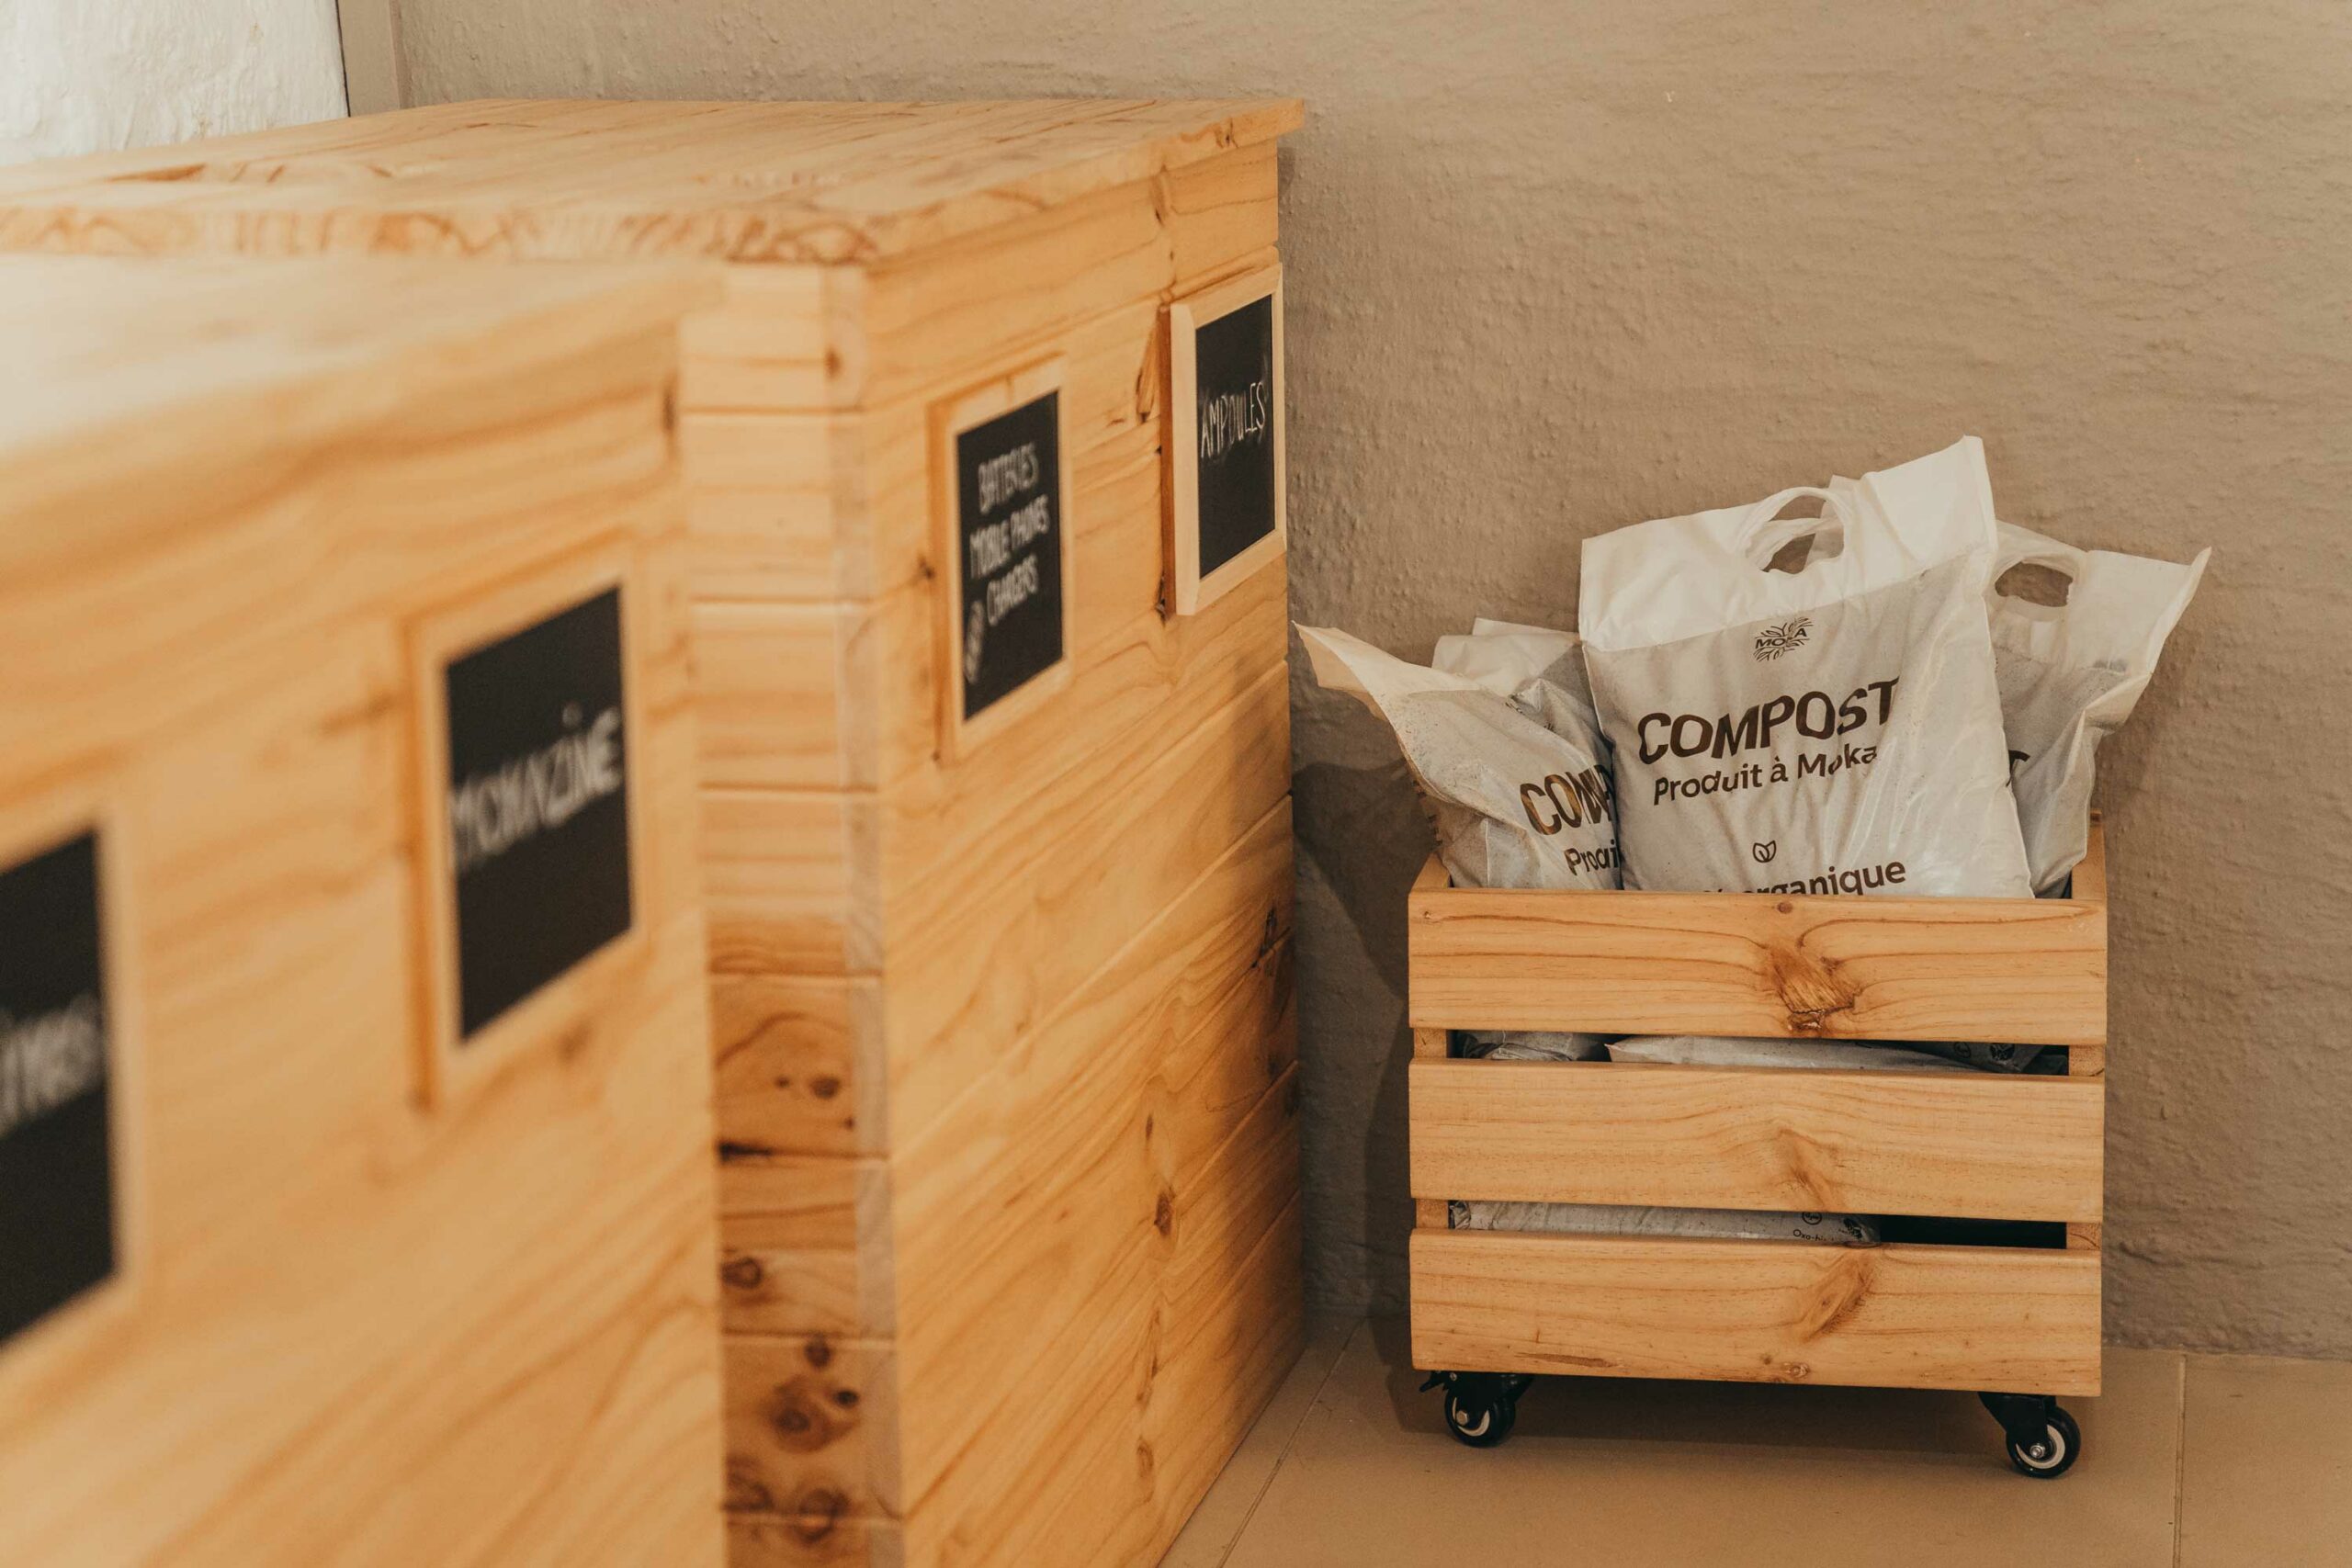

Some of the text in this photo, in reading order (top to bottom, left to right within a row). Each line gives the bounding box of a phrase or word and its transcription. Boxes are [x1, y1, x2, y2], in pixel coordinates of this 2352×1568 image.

[1201, 381, 1266, 458] AMPOULES
[1637, 676, 1899, 765] COMPOST
[1654, 742, 1878, 806] Produit à Moka
